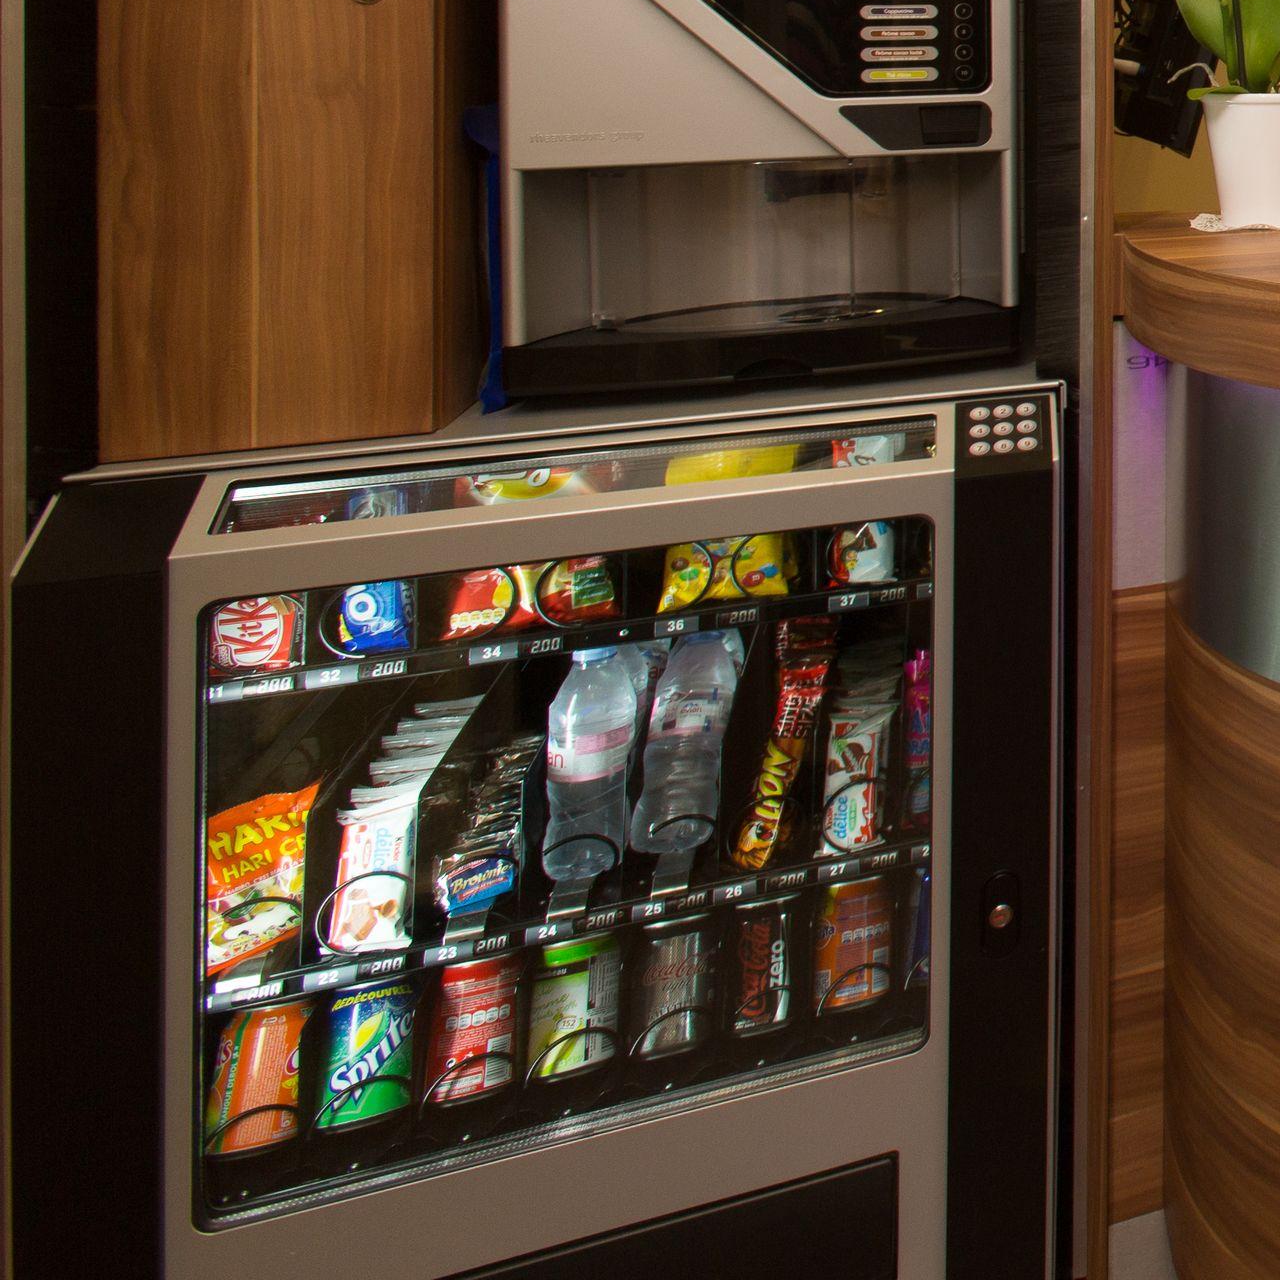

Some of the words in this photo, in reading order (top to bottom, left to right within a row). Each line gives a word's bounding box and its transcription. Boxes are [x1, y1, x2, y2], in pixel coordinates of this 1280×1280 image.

[840, 594, 856, 607] 37
[667, 619, 684, 632] 36
[483, 645, 502, 659] 34
[320, 669, 341, 683] 32
[755, 740, 792, 821] LION
[222, 848, 273, 883] HARI
[829, 863, 847, 877] 27
[450, 863, 511, 893] Brownie
[725, 885, 743, 899] 26
[644, 903, 662, 916] 25
[538, 925, 558, 939] 24
[438, 946, 458, 960] 23
[769, 940, 785, 988] zero
[318, 970, 340, 985] 22
[329, 1009, 416, 1112] Sprite
